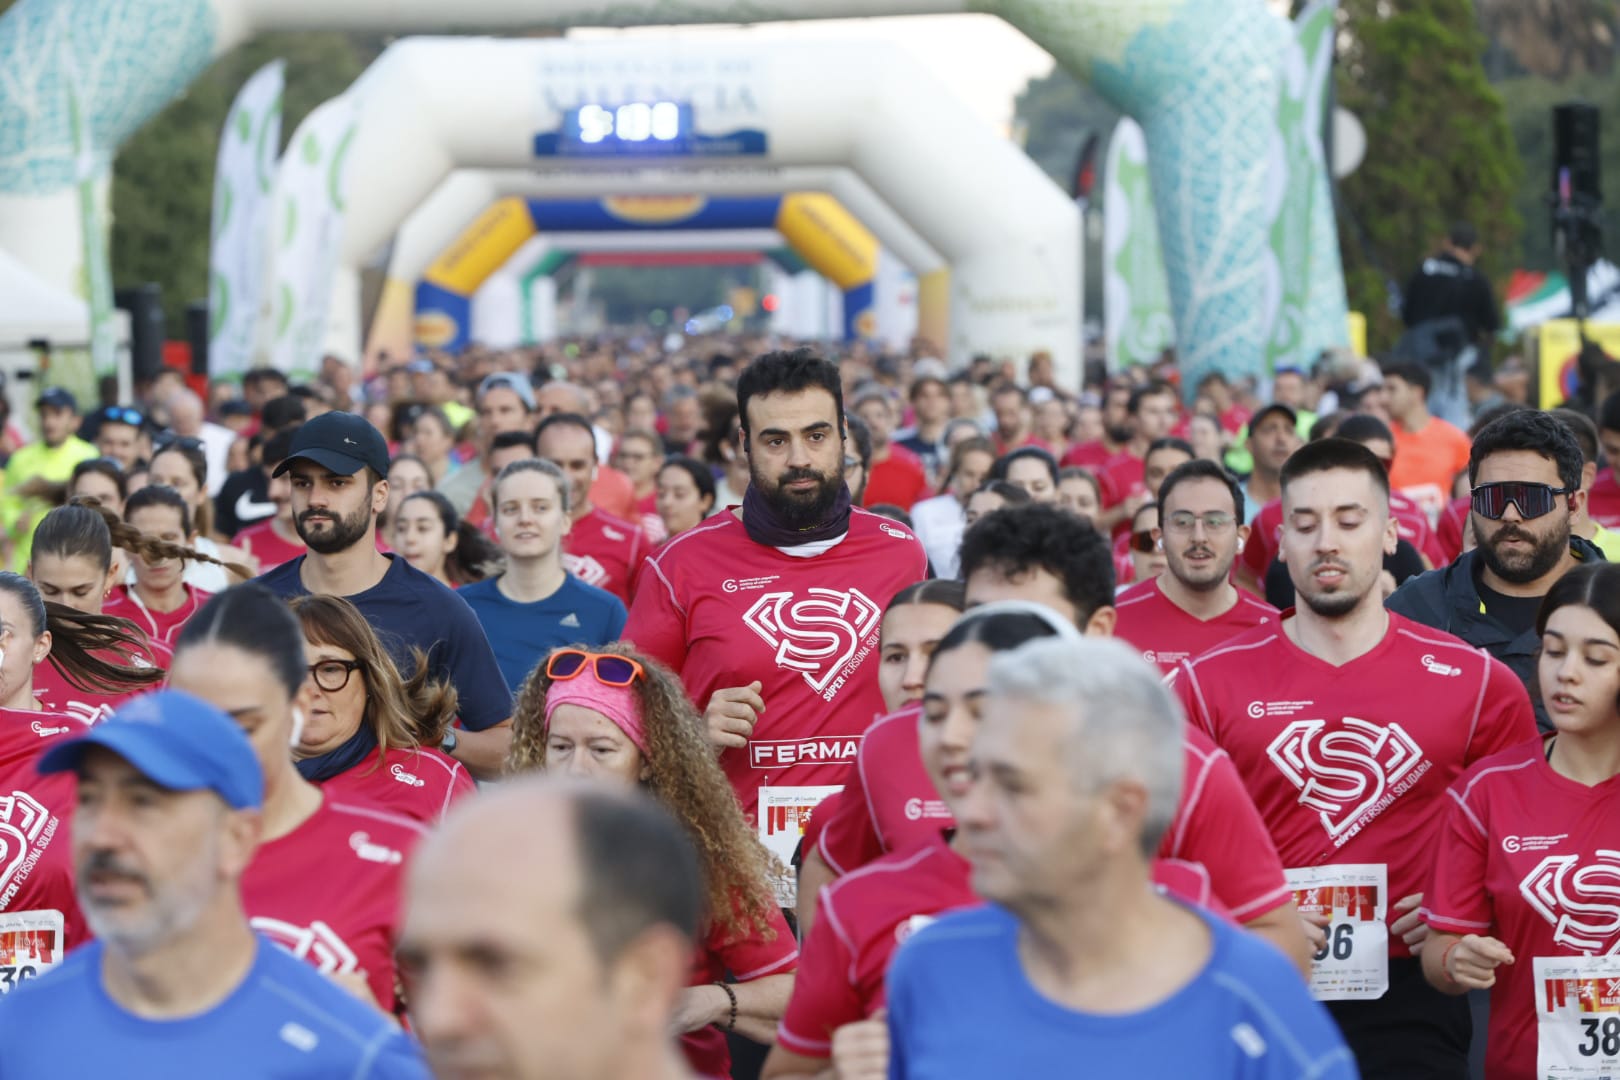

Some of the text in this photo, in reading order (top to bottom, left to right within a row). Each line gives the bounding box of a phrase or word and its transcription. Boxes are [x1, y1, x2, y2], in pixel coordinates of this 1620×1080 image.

[822, 676, 846, 702] SÚPER
[841, 646, 871, 678] PERSONA
[754, 740, 858, 763] FERMA
[1359, 793, 1396, 826] PERSONA
[1393, 760, 1433, 797] SOLIDARIA
[13, 848, 43, 885] PERSONA
